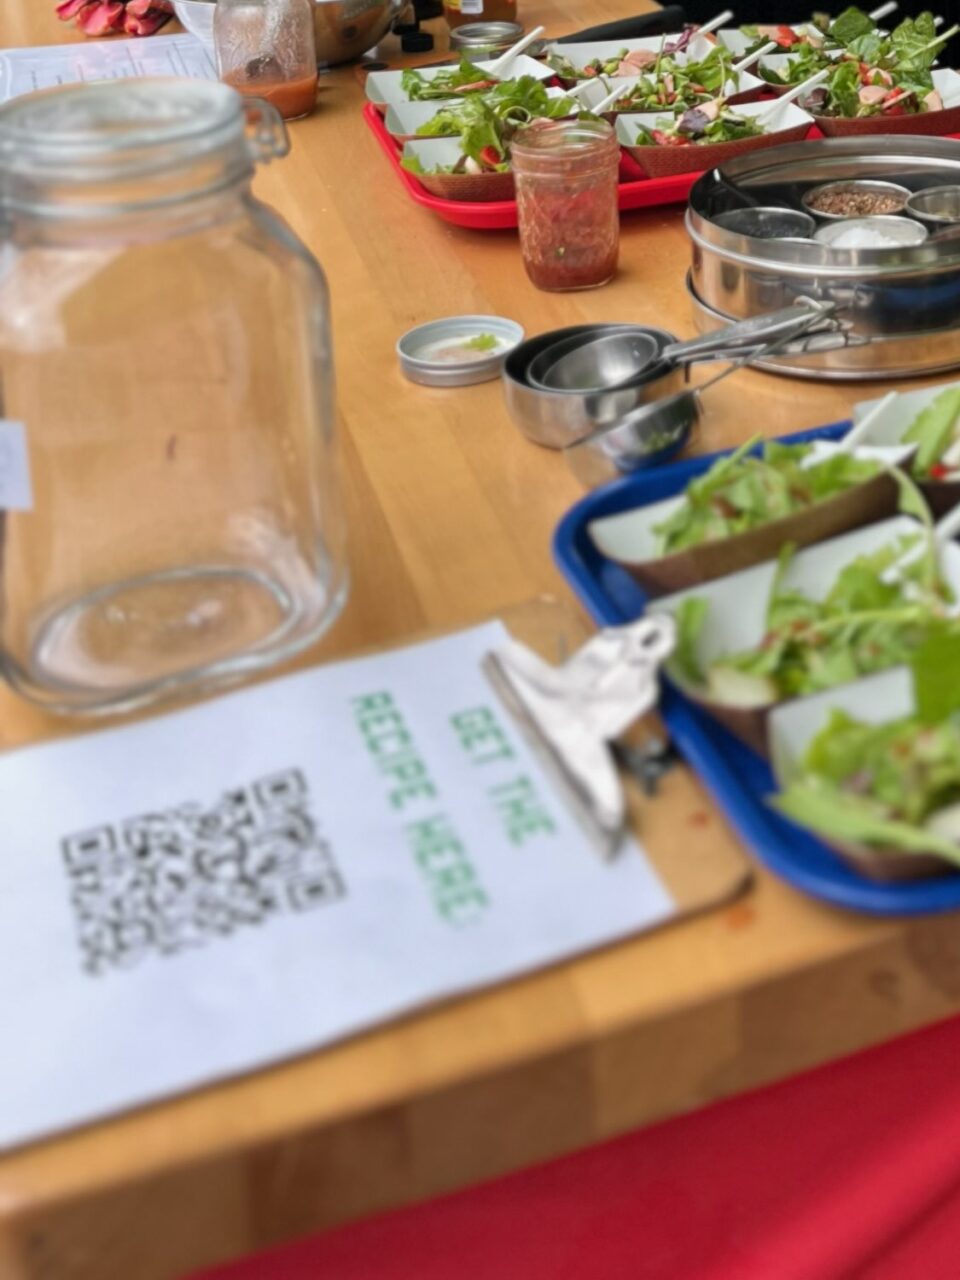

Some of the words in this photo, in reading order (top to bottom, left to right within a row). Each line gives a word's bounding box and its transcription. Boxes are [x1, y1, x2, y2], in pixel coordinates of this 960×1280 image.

[350, 690, 438, 811] RECIPE
[450, 705, 516, 766] GET
[487, 775, 557, 847] THE
